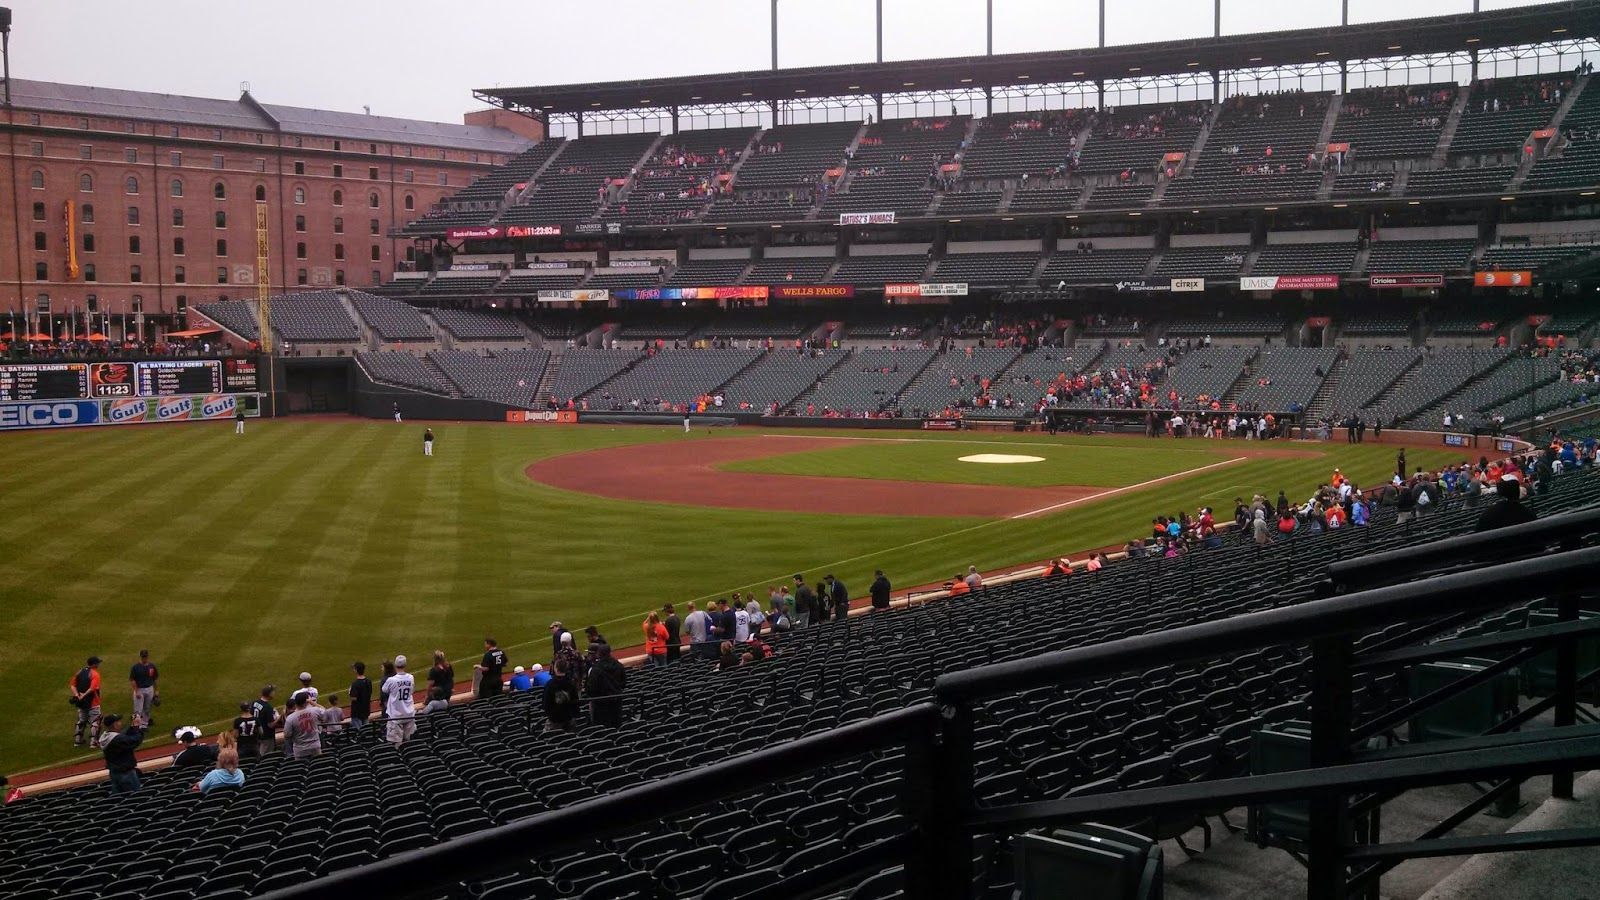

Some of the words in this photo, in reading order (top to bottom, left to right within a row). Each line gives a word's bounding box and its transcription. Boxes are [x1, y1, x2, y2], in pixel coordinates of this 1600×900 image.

[886, 286, 901, 294] NEED
[1242, 278, 1274, 288] UMBC
[99, 386, 129, 394] 11:23
[0, 404, 78, 425] EICO
[112, 402, 144, 420] Gulf
[159, 400, 190, 418] Gulf
[204, 398, 234, 417] Gulf
[496, 656, 502, 664] 15
[399, 688, 410, 700] 18
[240, 720, 256, 736] 17
